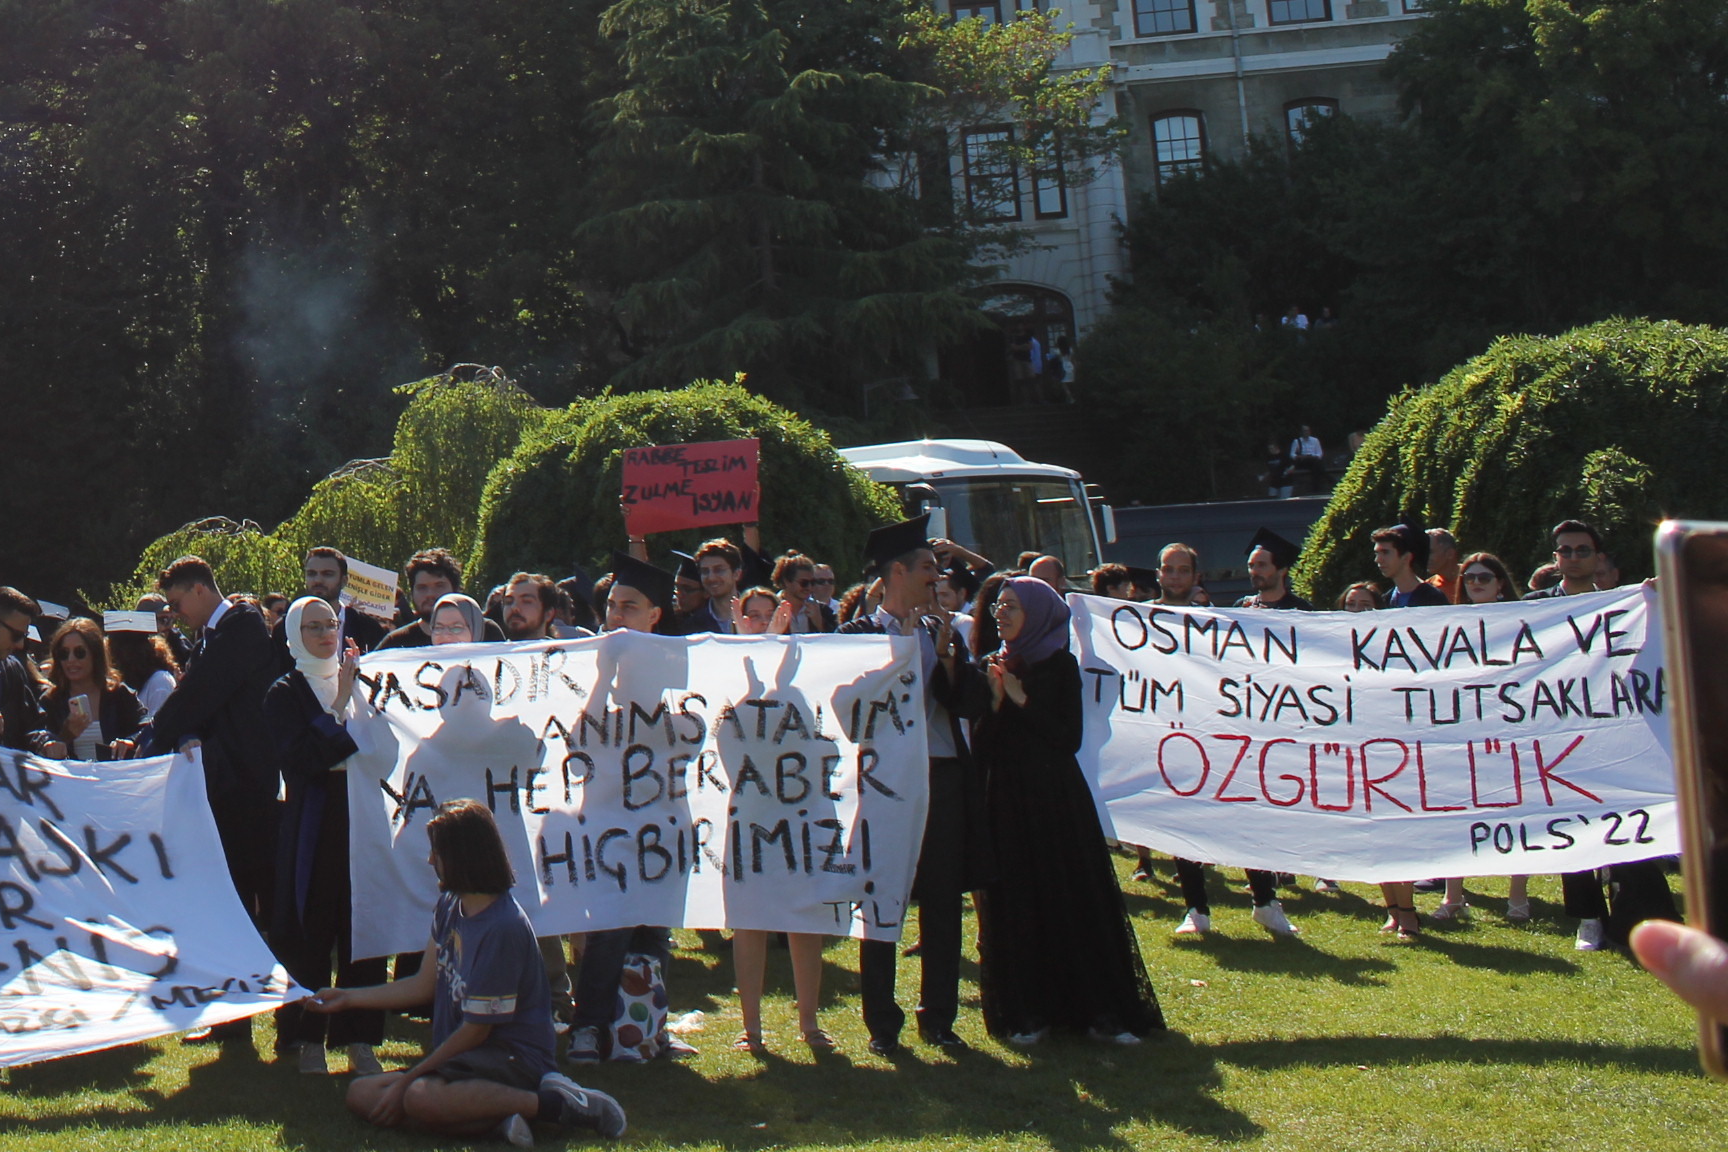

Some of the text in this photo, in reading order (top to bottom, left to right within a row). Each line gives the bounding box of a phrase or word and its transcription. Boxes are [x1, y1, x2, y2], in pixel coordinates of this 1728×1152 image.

[623, 479, 694, 505] ZULME
[1111, 605, 1643, 674] OSMAN KAVALA VE
[1084, 667, 1184, 716] TÜM
[1216, 673, 1354, 726] SİYASİ
[379, 743, 906, 827] YA HEP BERABER
[1157, 722, 1604, 814] ÖZGÜRLÜK
